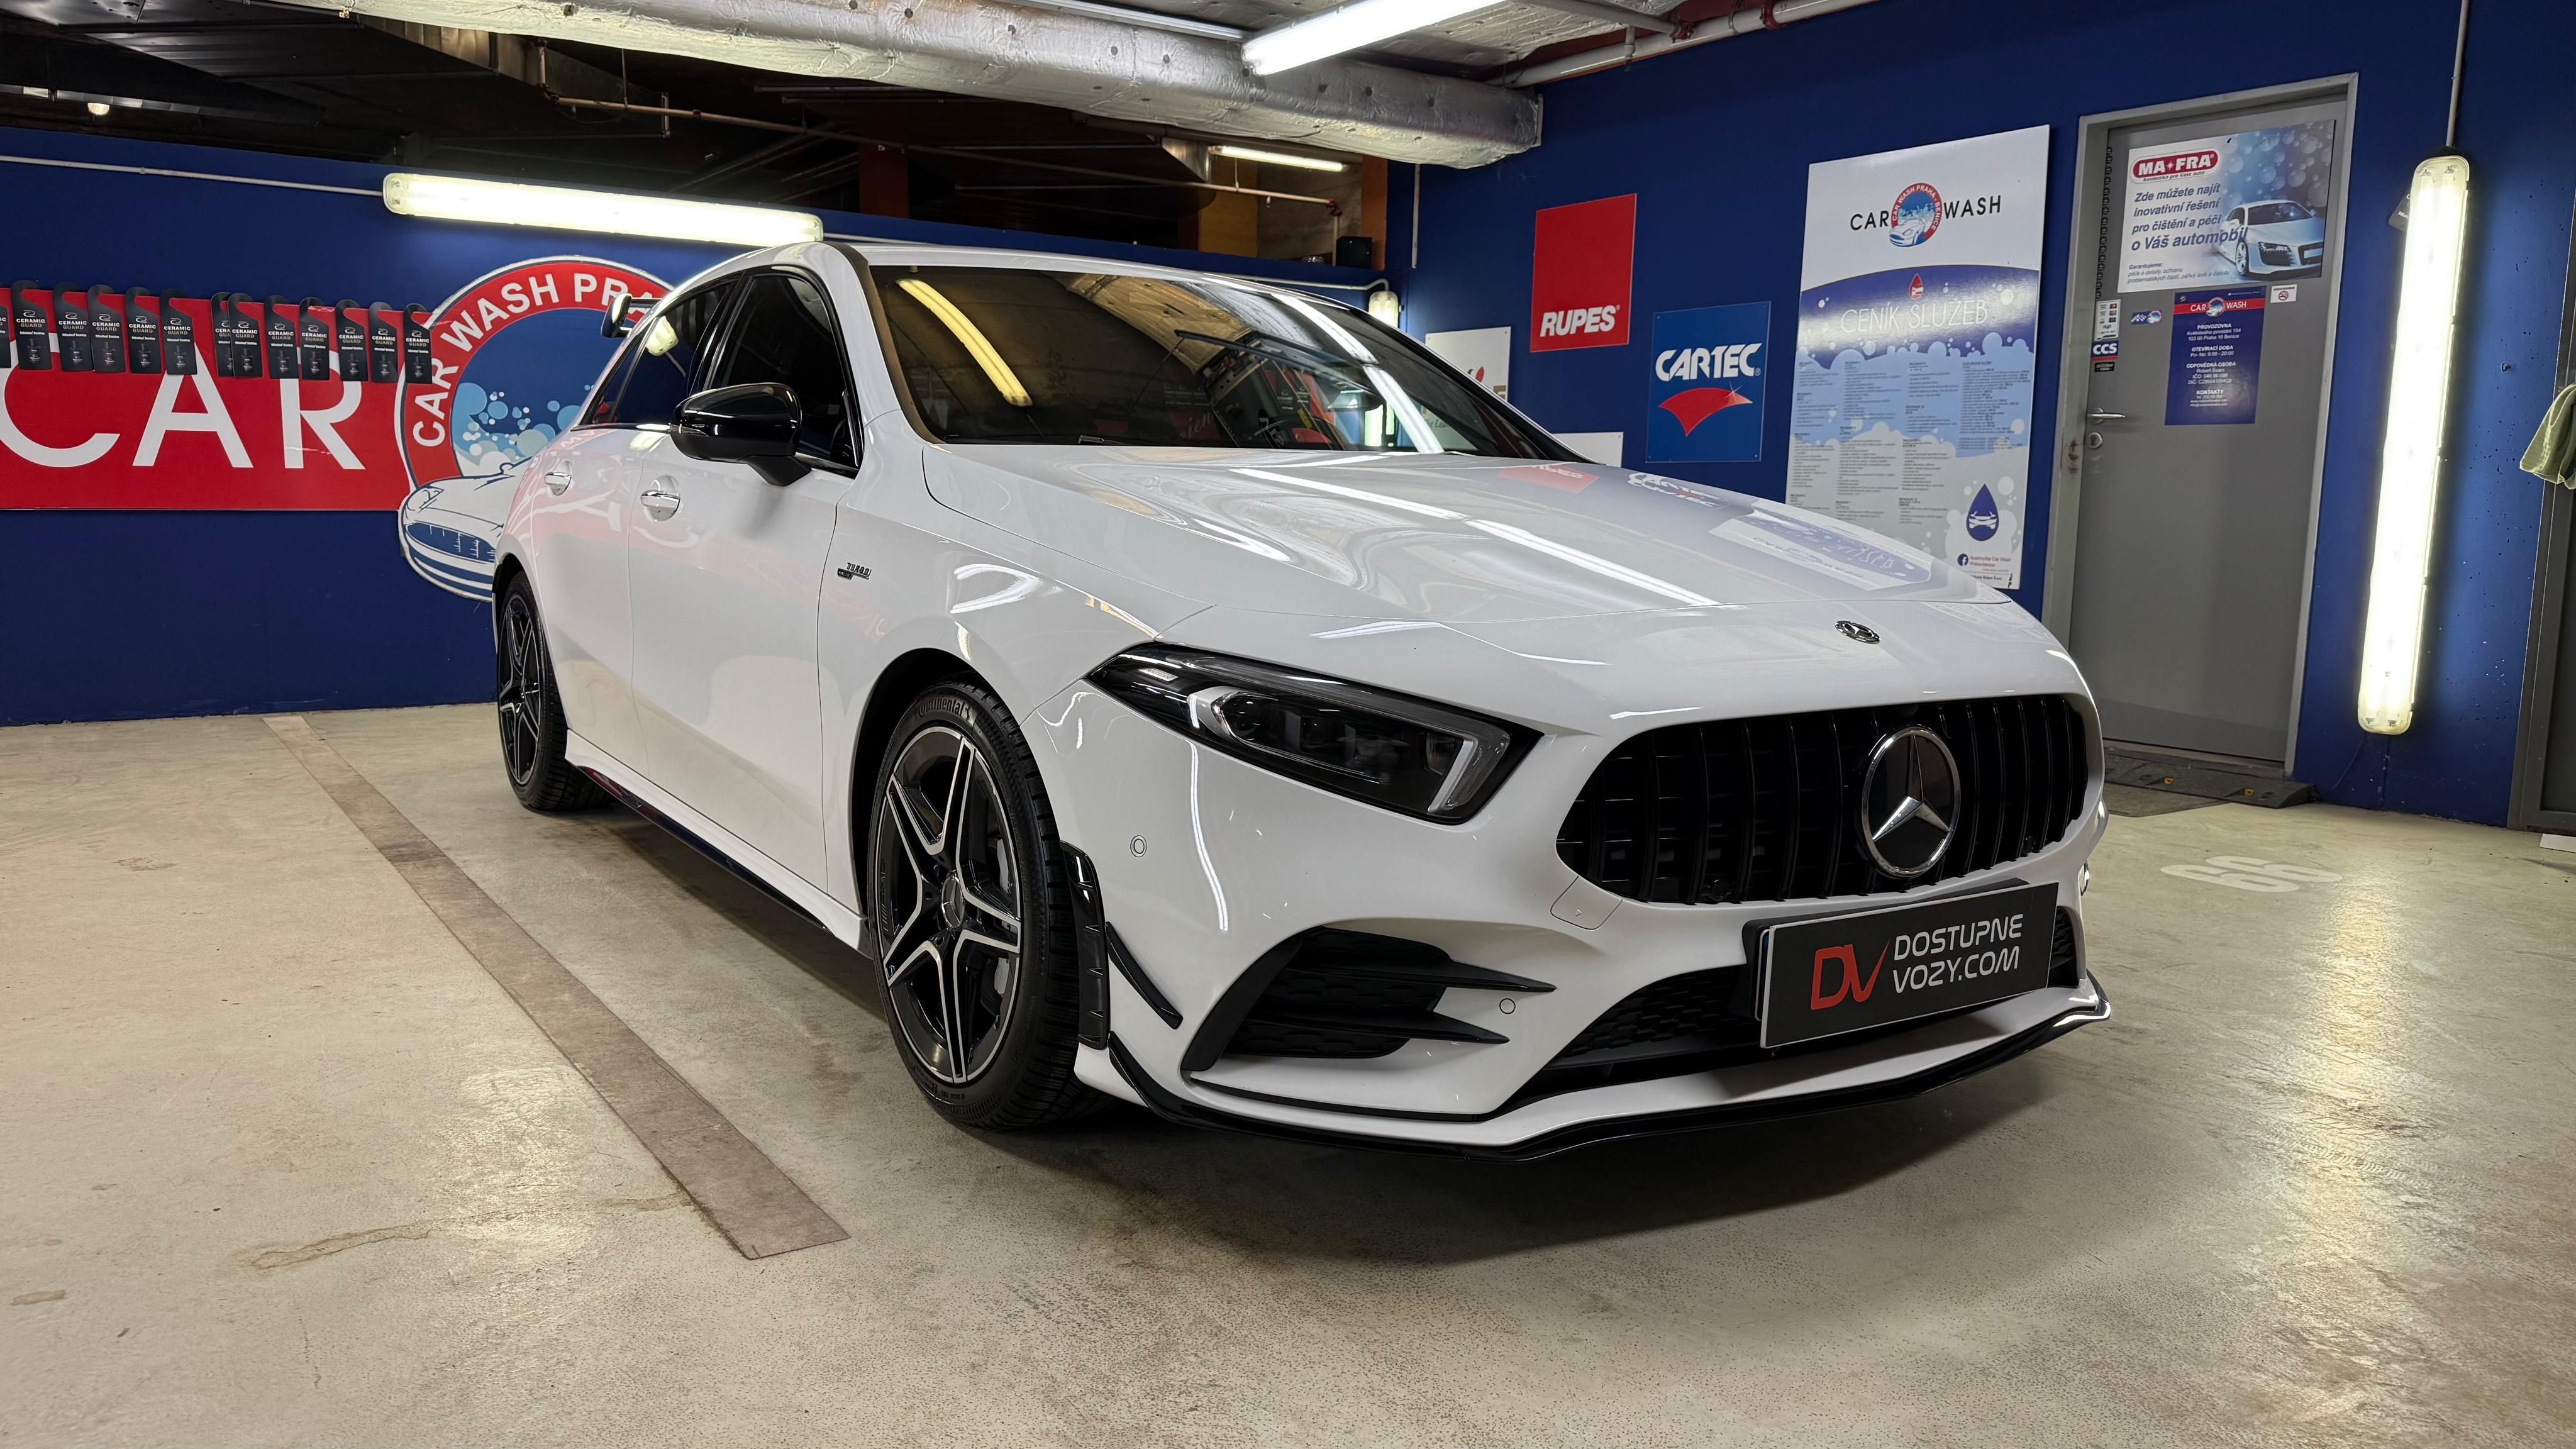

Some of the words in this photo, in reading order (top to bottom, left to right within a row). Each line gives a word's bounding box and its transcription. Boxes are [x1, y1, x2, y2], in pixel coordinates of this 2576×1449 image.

[1892, 204, 1901, 221] CAR
[1898, 186, 1914, 203] WASH
[1916, 185, 1935, 198] PRAHA
[1931, 201, 1940, 230] BENICE
[2133, 202, 2185, 216] inovativní
[2186, 197, 2220, 211] řešení
[2135, 192, 2153, 203] Zde
[2157, 187, 2194, 200] můžete
[2196, 182, 2220, 196] najít
[1850, 210, 1889, 231] CAR
[1943, 195, 2001, 219] WASH
[2132, 225, 2149, 235] pro
[2152, 218, 2188, 230] čištění
[2189, 219, 2195, 227] a
[2197, 214, 2222, 228] péči
[2131, 241, 2141, 251] o
[2145, 235, 2169, 249] Váš
[2172, 226, 2249, 247] automobil
[1540, 305, 1617, 337] RUPES
[1841, 302, 1900, 333] CENÍK
[1908, 293, 1989, 328] SLUŽEB
[2190, 304, 2206, 312] CAR
[2226, 301, 2246, 309] WASH
[413, 357, 458, 447] CAR
[440, 273, 560, 352] WASH
[1655, 343, 1762, 382] CARTEC
[2093, 343, 2117, 355] CCS
[0, 332, 365, 469] CAR
[918, 696, 965, 717] Continental
[1894, 913, 2024, 961] DOSTUPNE
[1810, 939, 1891, 1010] DV
[1892, 945, 2019, 994] VOZY.COM
